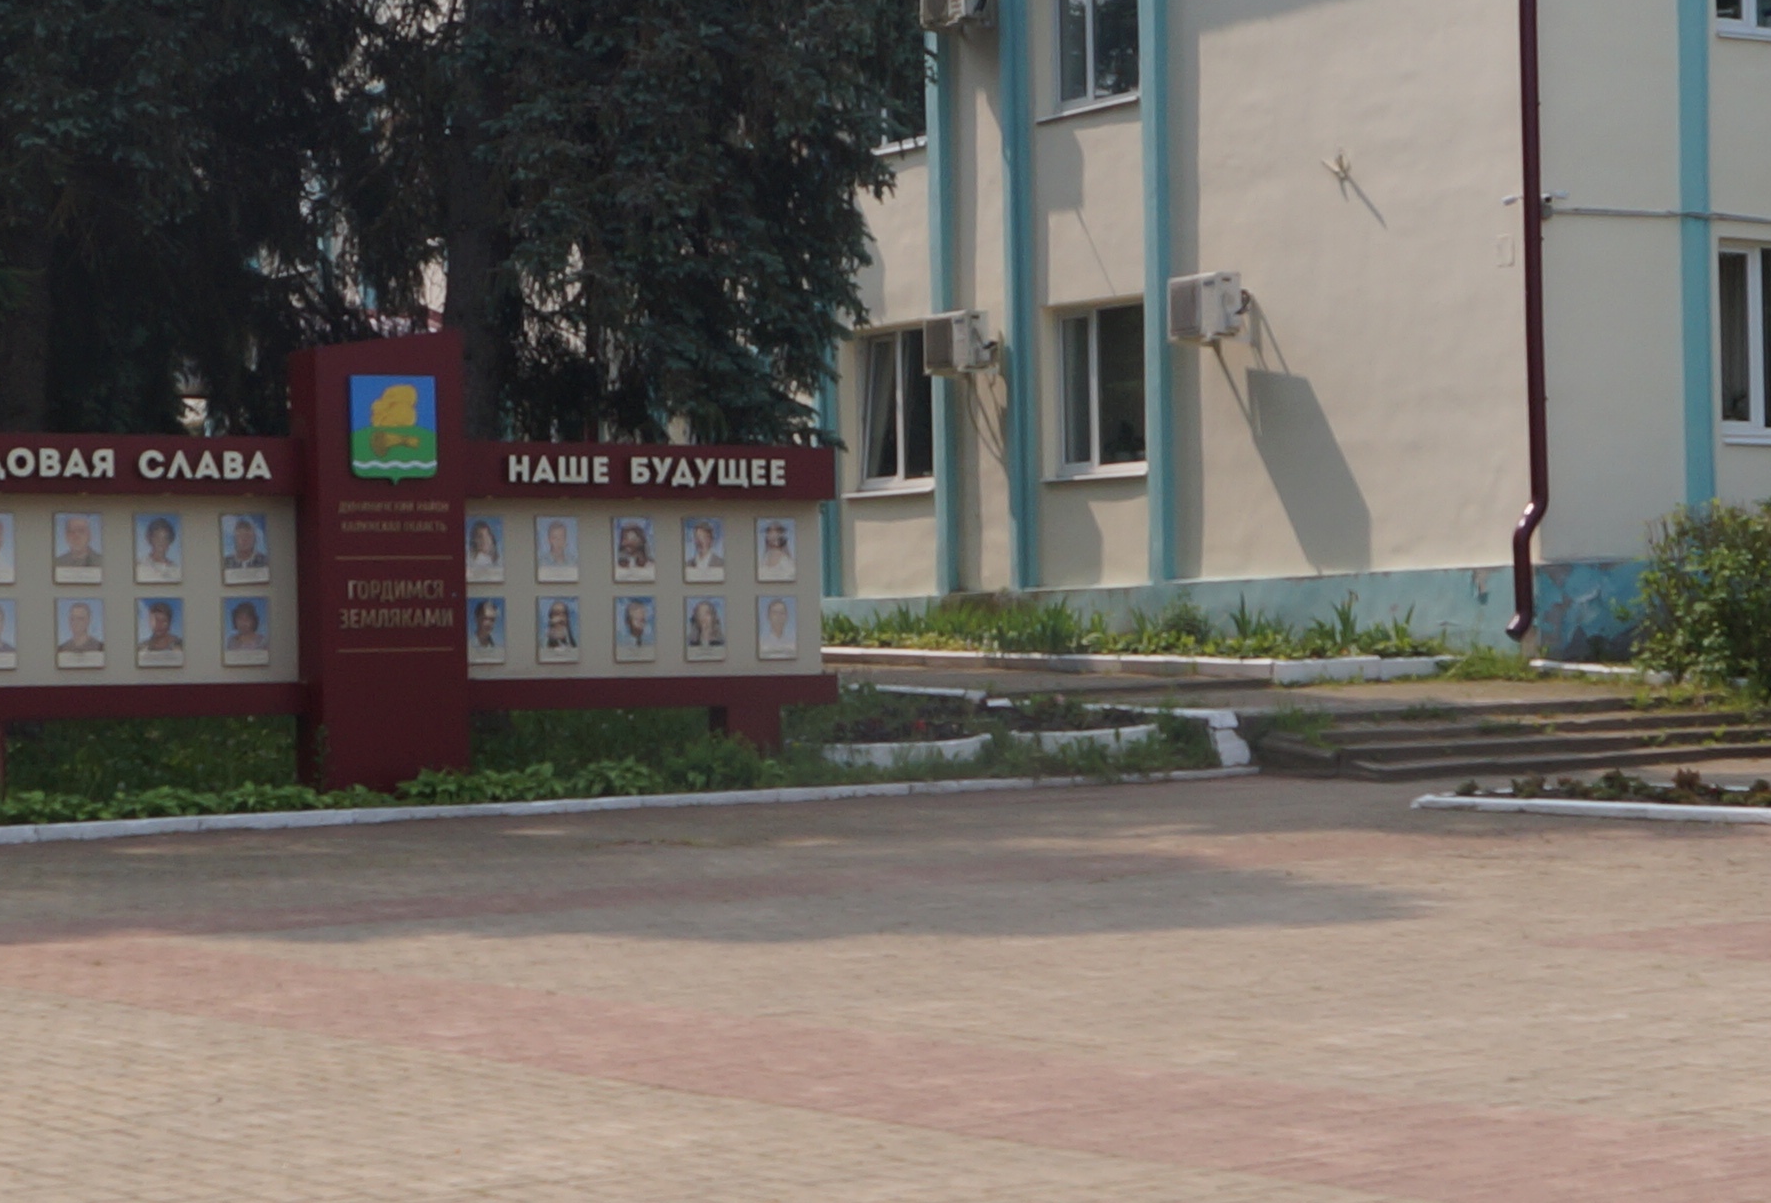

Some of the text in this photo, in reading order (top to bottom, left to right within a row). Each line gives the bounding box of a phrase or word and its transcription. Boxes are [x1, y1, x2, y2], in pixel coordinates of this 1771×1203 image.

[137, 449, 273, 481] СЛАВА
[508, 454, 787, 489] НАШЕ БУДУЩЕЕ
[346, 579, 445, 603] ГОРДИМСЯ
[338, 607, 454, 629] ЗЕМЛЯКАМИ
